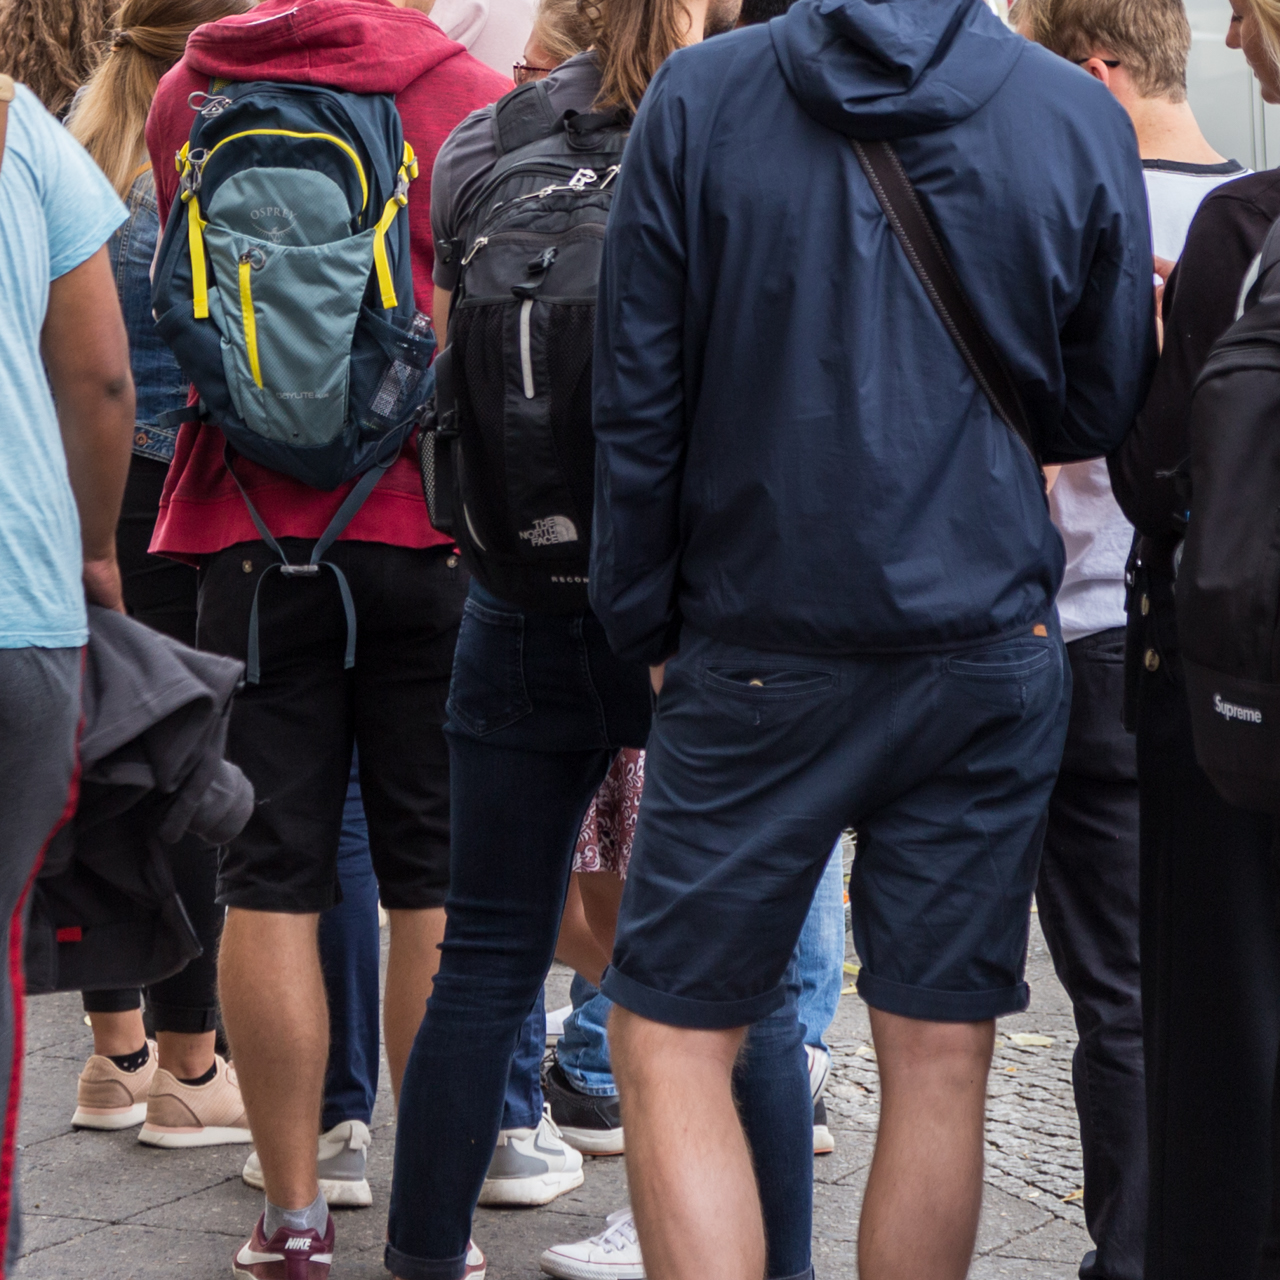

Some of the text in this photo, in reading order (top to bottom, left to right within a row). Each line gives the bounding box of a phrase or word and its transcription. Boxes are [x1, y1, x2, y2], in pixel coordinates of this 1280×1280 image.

[250, 207, 298, 220] OSPREY
[532, 517, 556, 529] THE
[519, 525, 557, 540] NORTH
[531, 535, 560, 547] FACE
[551, 575, 590, 584] RECON
[1214, 694, 1263, 724] Supreme
[284, 1237, 312, 1250] NIKE
